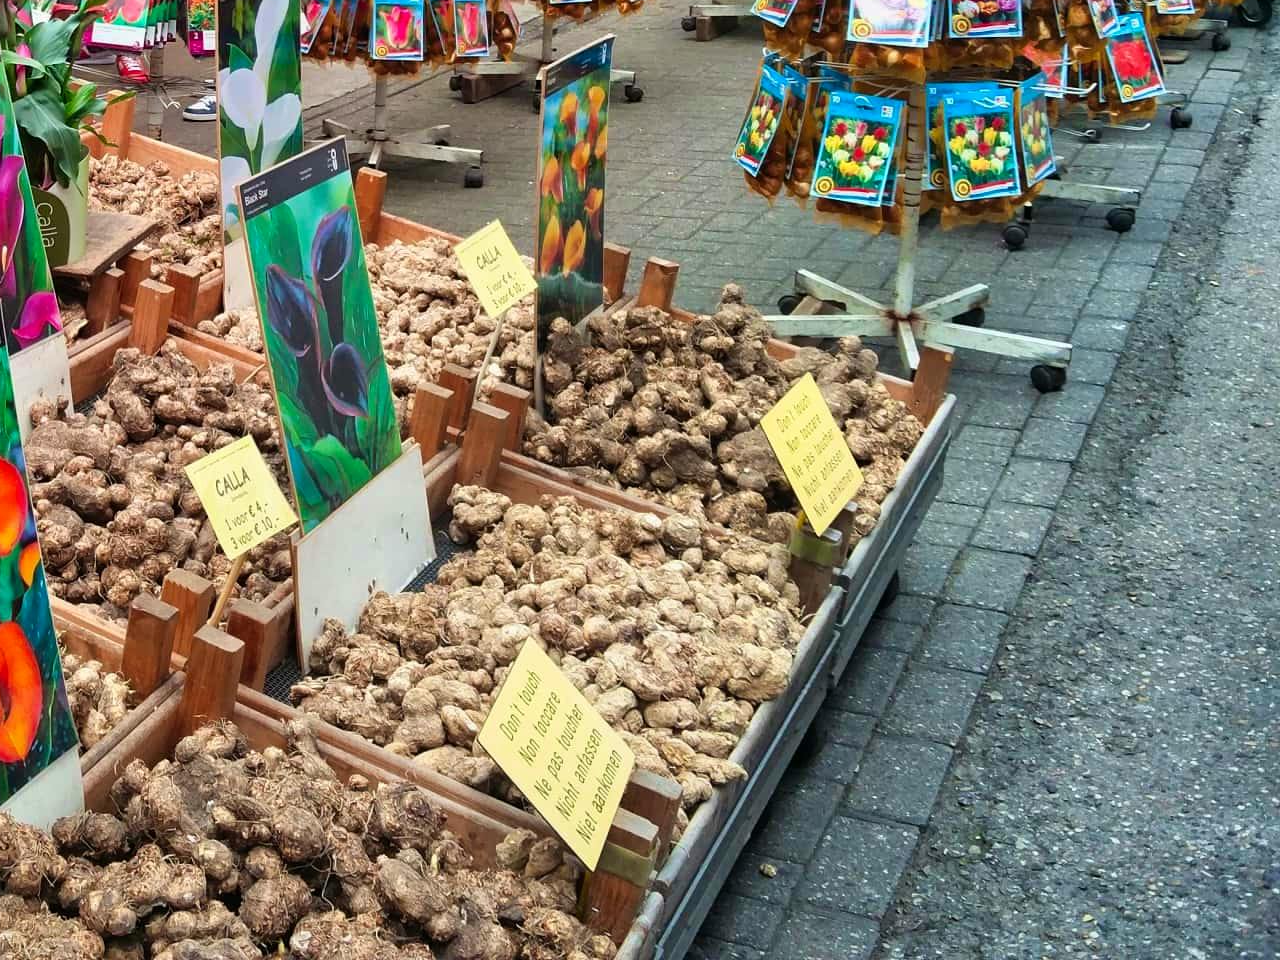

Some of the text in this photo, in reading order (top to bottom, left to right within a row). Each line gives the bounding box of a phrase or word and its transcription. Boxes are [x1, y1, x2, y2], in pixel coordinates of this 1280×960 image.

[244, 188, 269, 206] Black Star
[36, 202, 58, 248] Calla
[477, 246, 502, 270] CALLA
[215, 466, 251, 497] CALLA
[230, 537, 239, 550] 3
[238, 530, 254, 545] voor
[254, 522, 262, 536] €
[232, 511, 248, 528] voor
[248, 505, 256, 518] €
[498, 670, 543, 742] Don't touch
[519, 690, 562, 766] Non toccare
[533, 702, 585, 801] Ne pas toucher
[555, 781, 581, 822] Nicht
[576, 749, 624, 846] Niet aankomen
